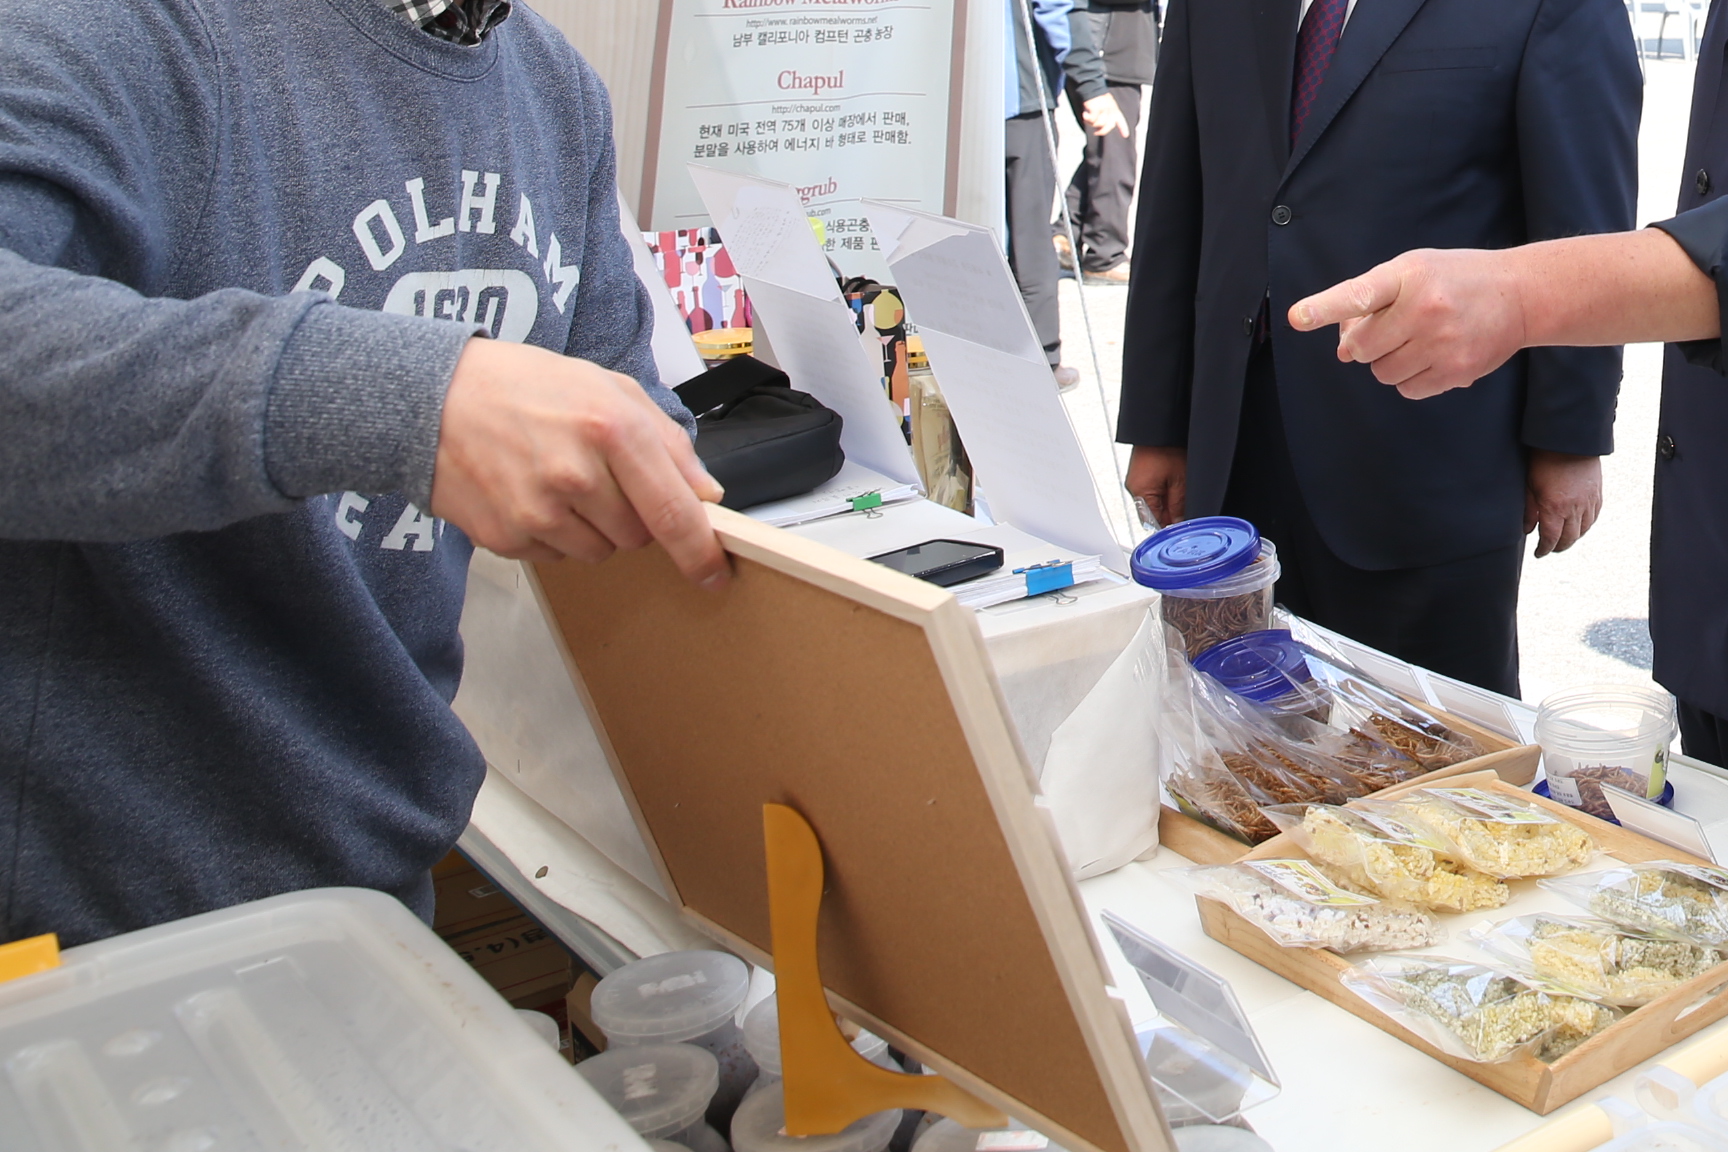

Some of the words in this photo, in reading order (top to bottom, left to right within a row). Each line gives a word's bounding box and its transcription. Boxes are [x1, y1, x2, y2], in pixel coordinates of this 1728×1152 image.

[732, 33, 753, 47] 남부
[757, 29, 809, 45] 캘리포니아
[814, 28, 848, 44] 컴프턴
[853, 28, 872, 43] 곤충
[874, 25, 893, 41] 농장
[777, 70, 844, 95] Chapul
[771, 103, 841, 115] http://chapul.com
[699, 123, 722, 139] 현재
[727, 122, 750, 136] 미국
[755, 120, 777, 135] 전역
[781, 118, 805, 133] 75개
[812, 117, 835, 132] 이상
[838, 112, 877, 129] 매장에서
[882, 112, 910, 126] 판매,
[694, 141, 729, 158] 분말을
[734, 138, 779, 155] 사용하여
[784, 137, 820, 152] 에너지
[825, 136, 835, 149] 바
[838, 130, 866, 148] 형태로
[872, 129, 912, 145] 판매함.
[840, 236, 865, 250] 제품
